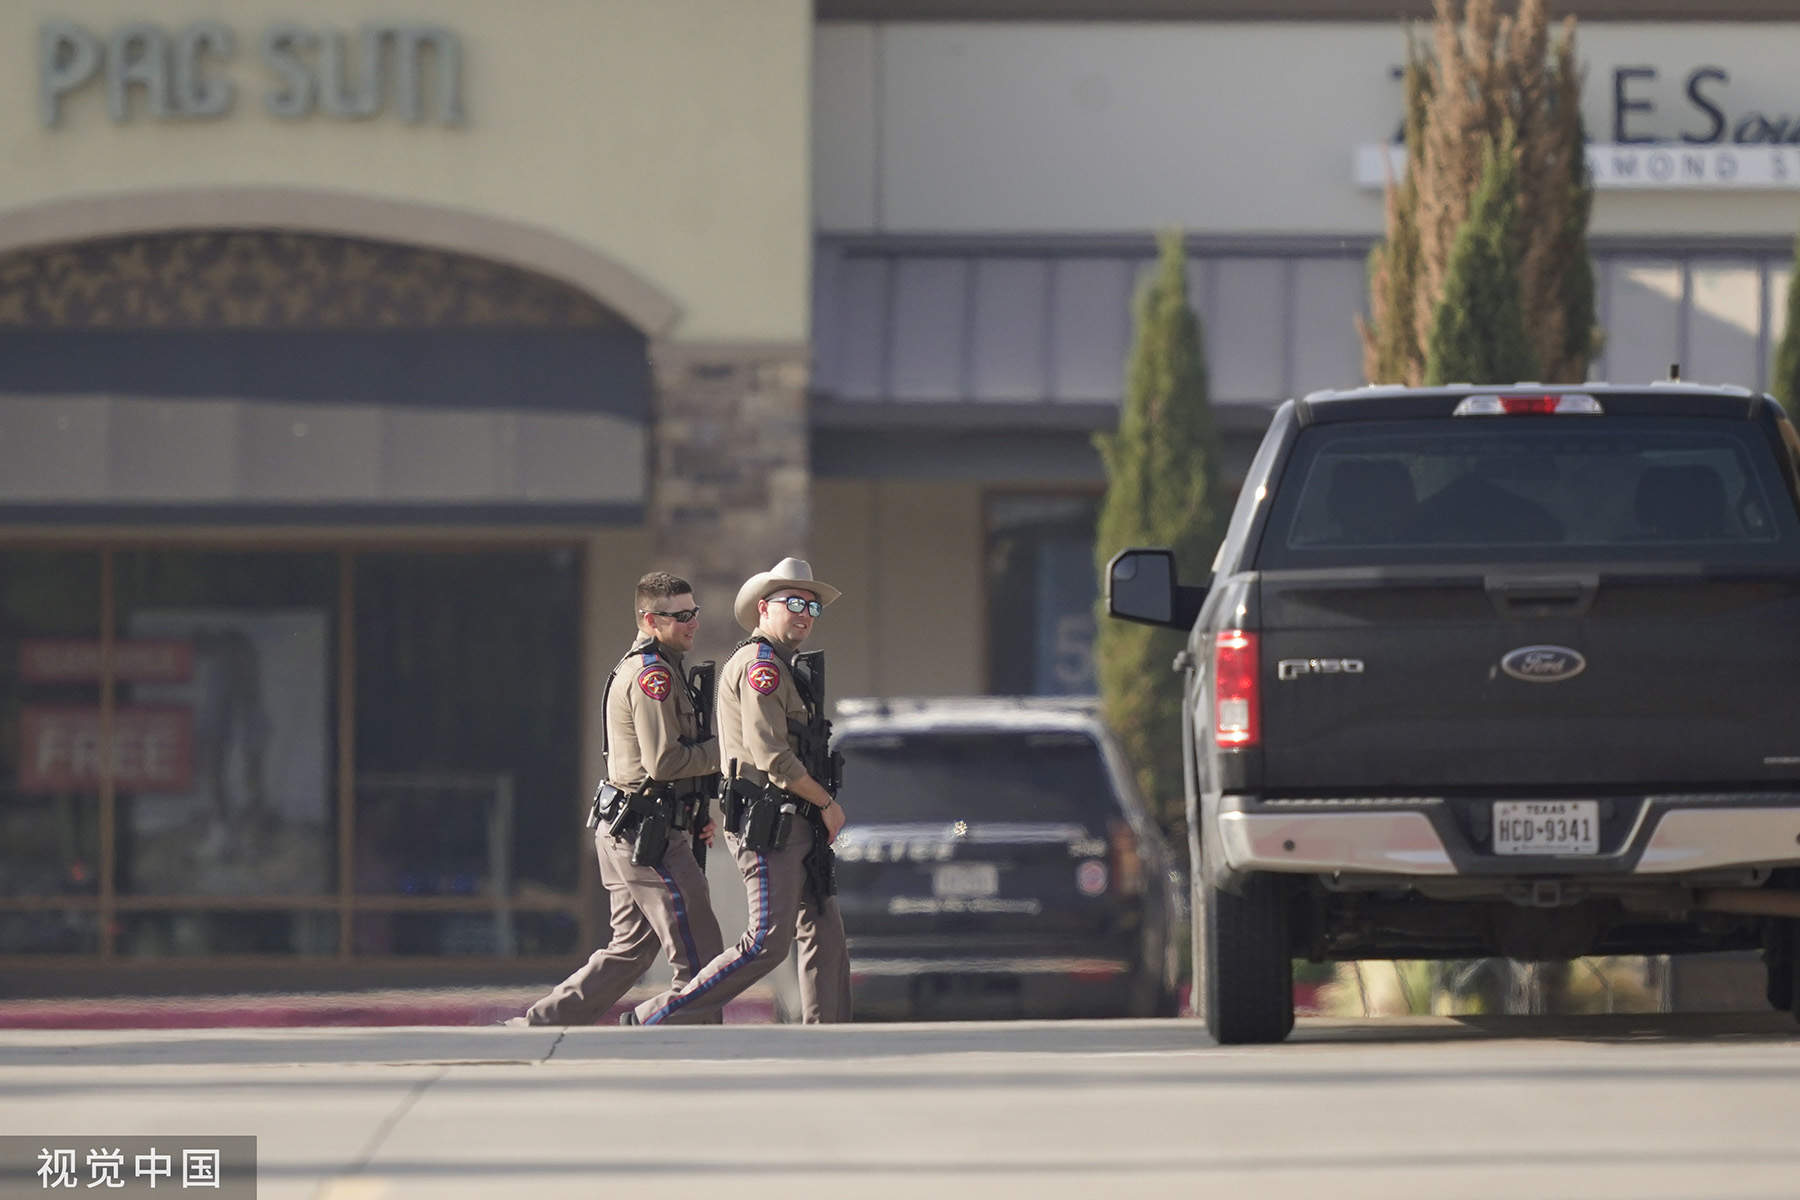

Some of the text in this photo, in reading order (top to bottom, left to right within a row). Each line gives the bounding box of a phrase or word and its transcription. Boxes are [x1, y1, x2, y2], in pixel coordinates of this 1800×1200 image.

[40, 20, 470, 130] PAC SUN
[1521, 652, 1566, 673] Ford
[36, 724, 178, 782] FREE
[1526, 804, 1567, 816] TEXAS
